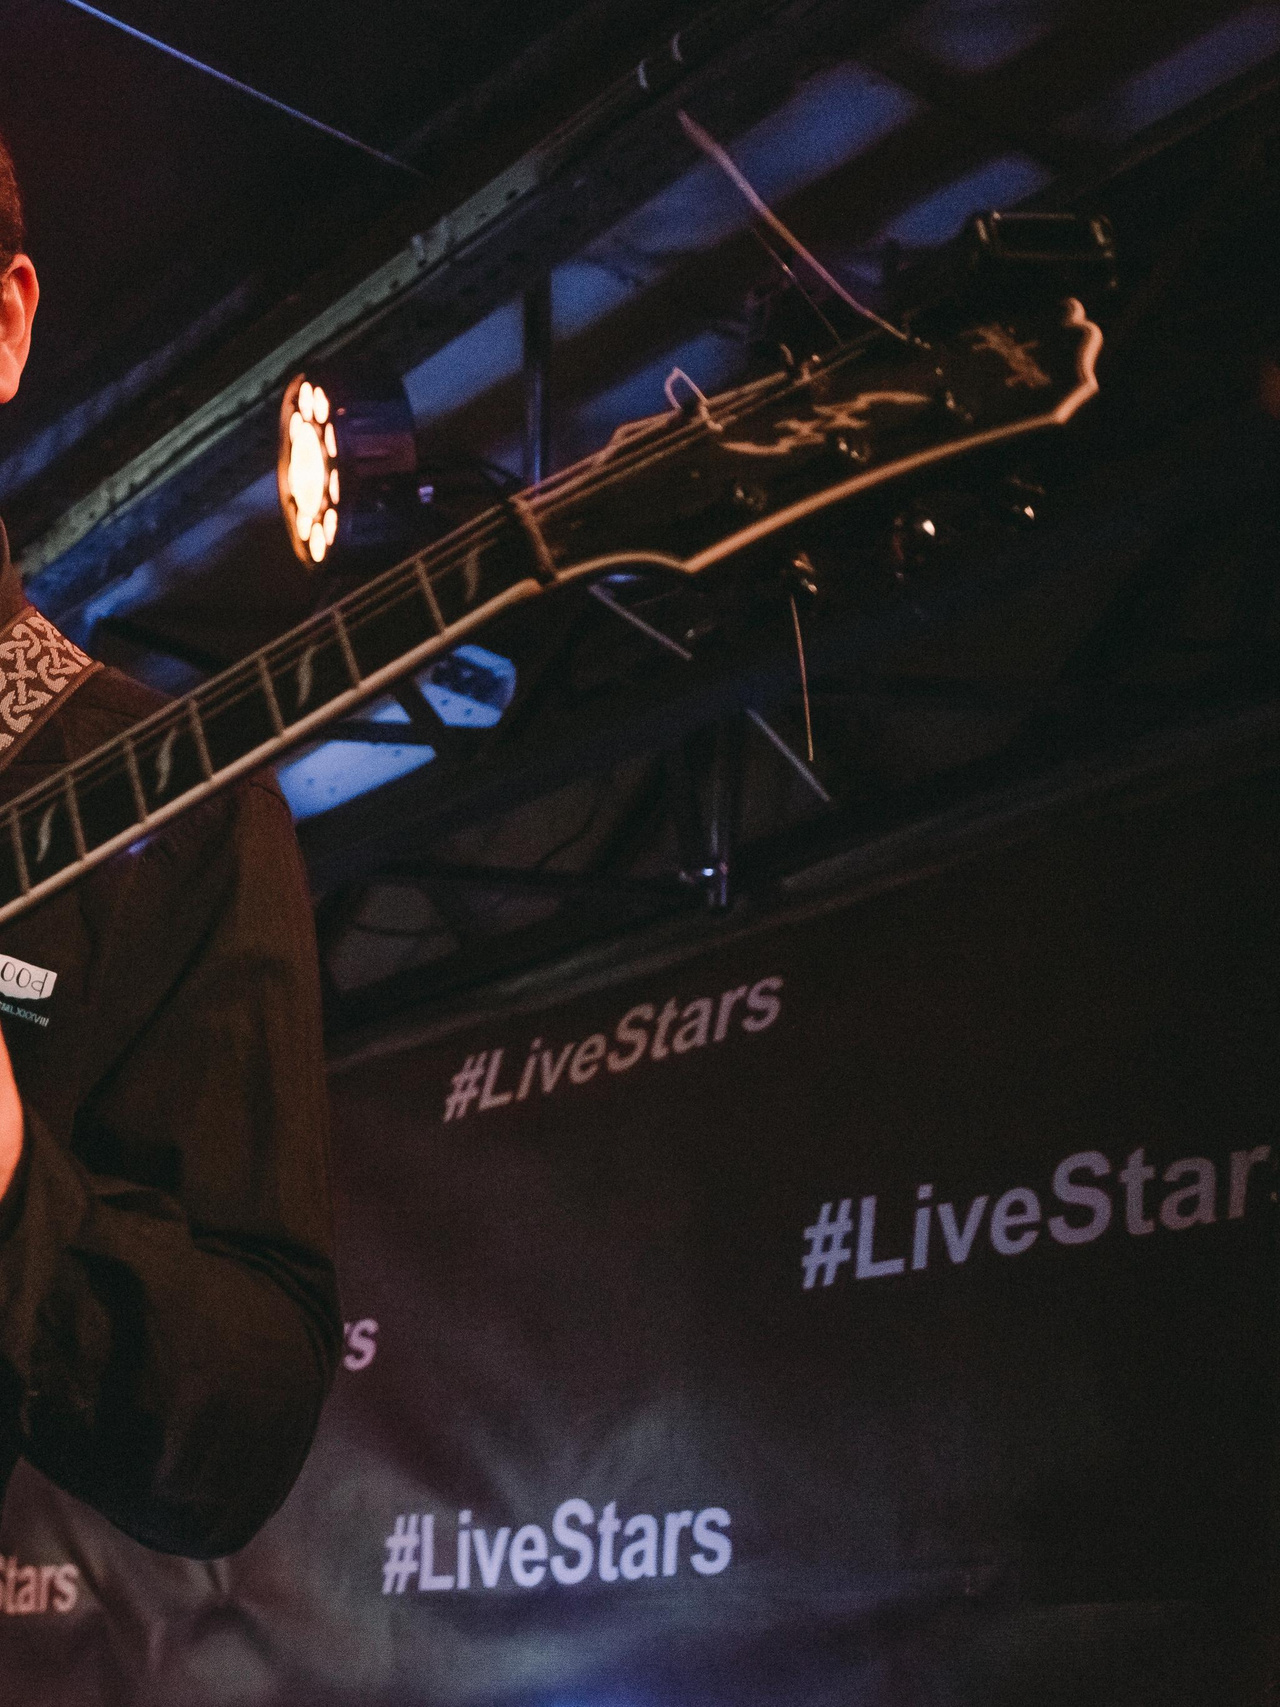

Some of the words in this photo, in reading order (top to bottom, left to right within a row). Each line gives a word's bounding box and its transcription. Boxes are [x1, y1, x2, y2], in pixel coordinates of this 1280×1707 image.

[443, 975, 784, 1122] #LiveStars
[801, 1145, 1278, 1290] #LiveStar
[382, 1497, 733, 1595] #LiveStars
